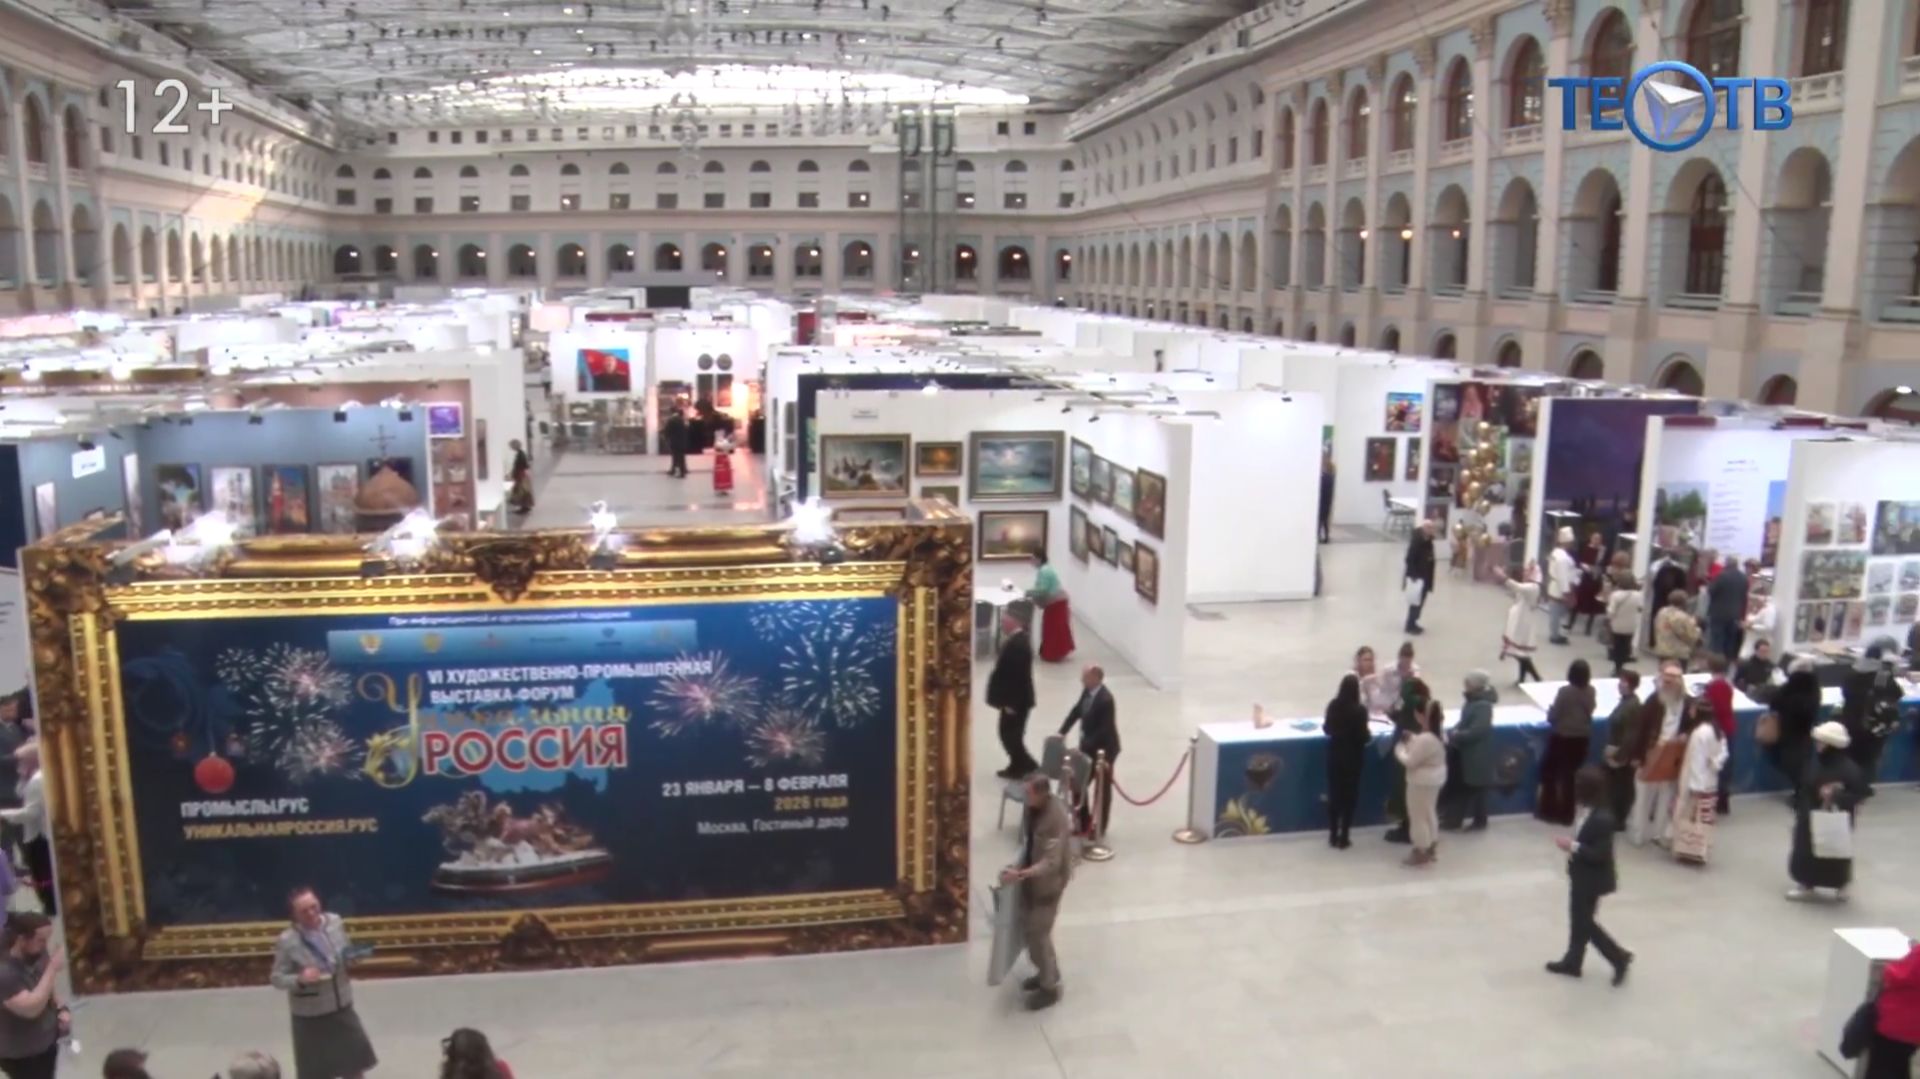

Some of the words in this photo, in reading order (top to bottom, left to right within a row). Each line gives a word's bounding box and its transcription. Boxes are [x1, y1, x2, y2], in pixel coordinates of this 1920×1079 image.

[427, 670, 443, 684] VI
[446, 660, 713, 686] ХУДОЖЕСТВЕННО-ПРОМЫШЛЕННАЯ
[430, 686, 575, 704] ВЫСТАВКА-ФОРУМ
[422, 725, 628, 775] РОССИЯ
[662, 782, 681, 797] 23
[685, 779, 744, 796] ЯНВАРЯ
[777, 774, 848, 790] ФЕВРАЛЯ
[180, 798, 310, 818] ПРОМЫСЛЫ.РУС
[183, 818, 379, 840] УНИКАЛЬНАЯРОССИЯ.РУС
[697, 821, 749, 835] Москва,
[753, 817, 814, 832] Гостиный
